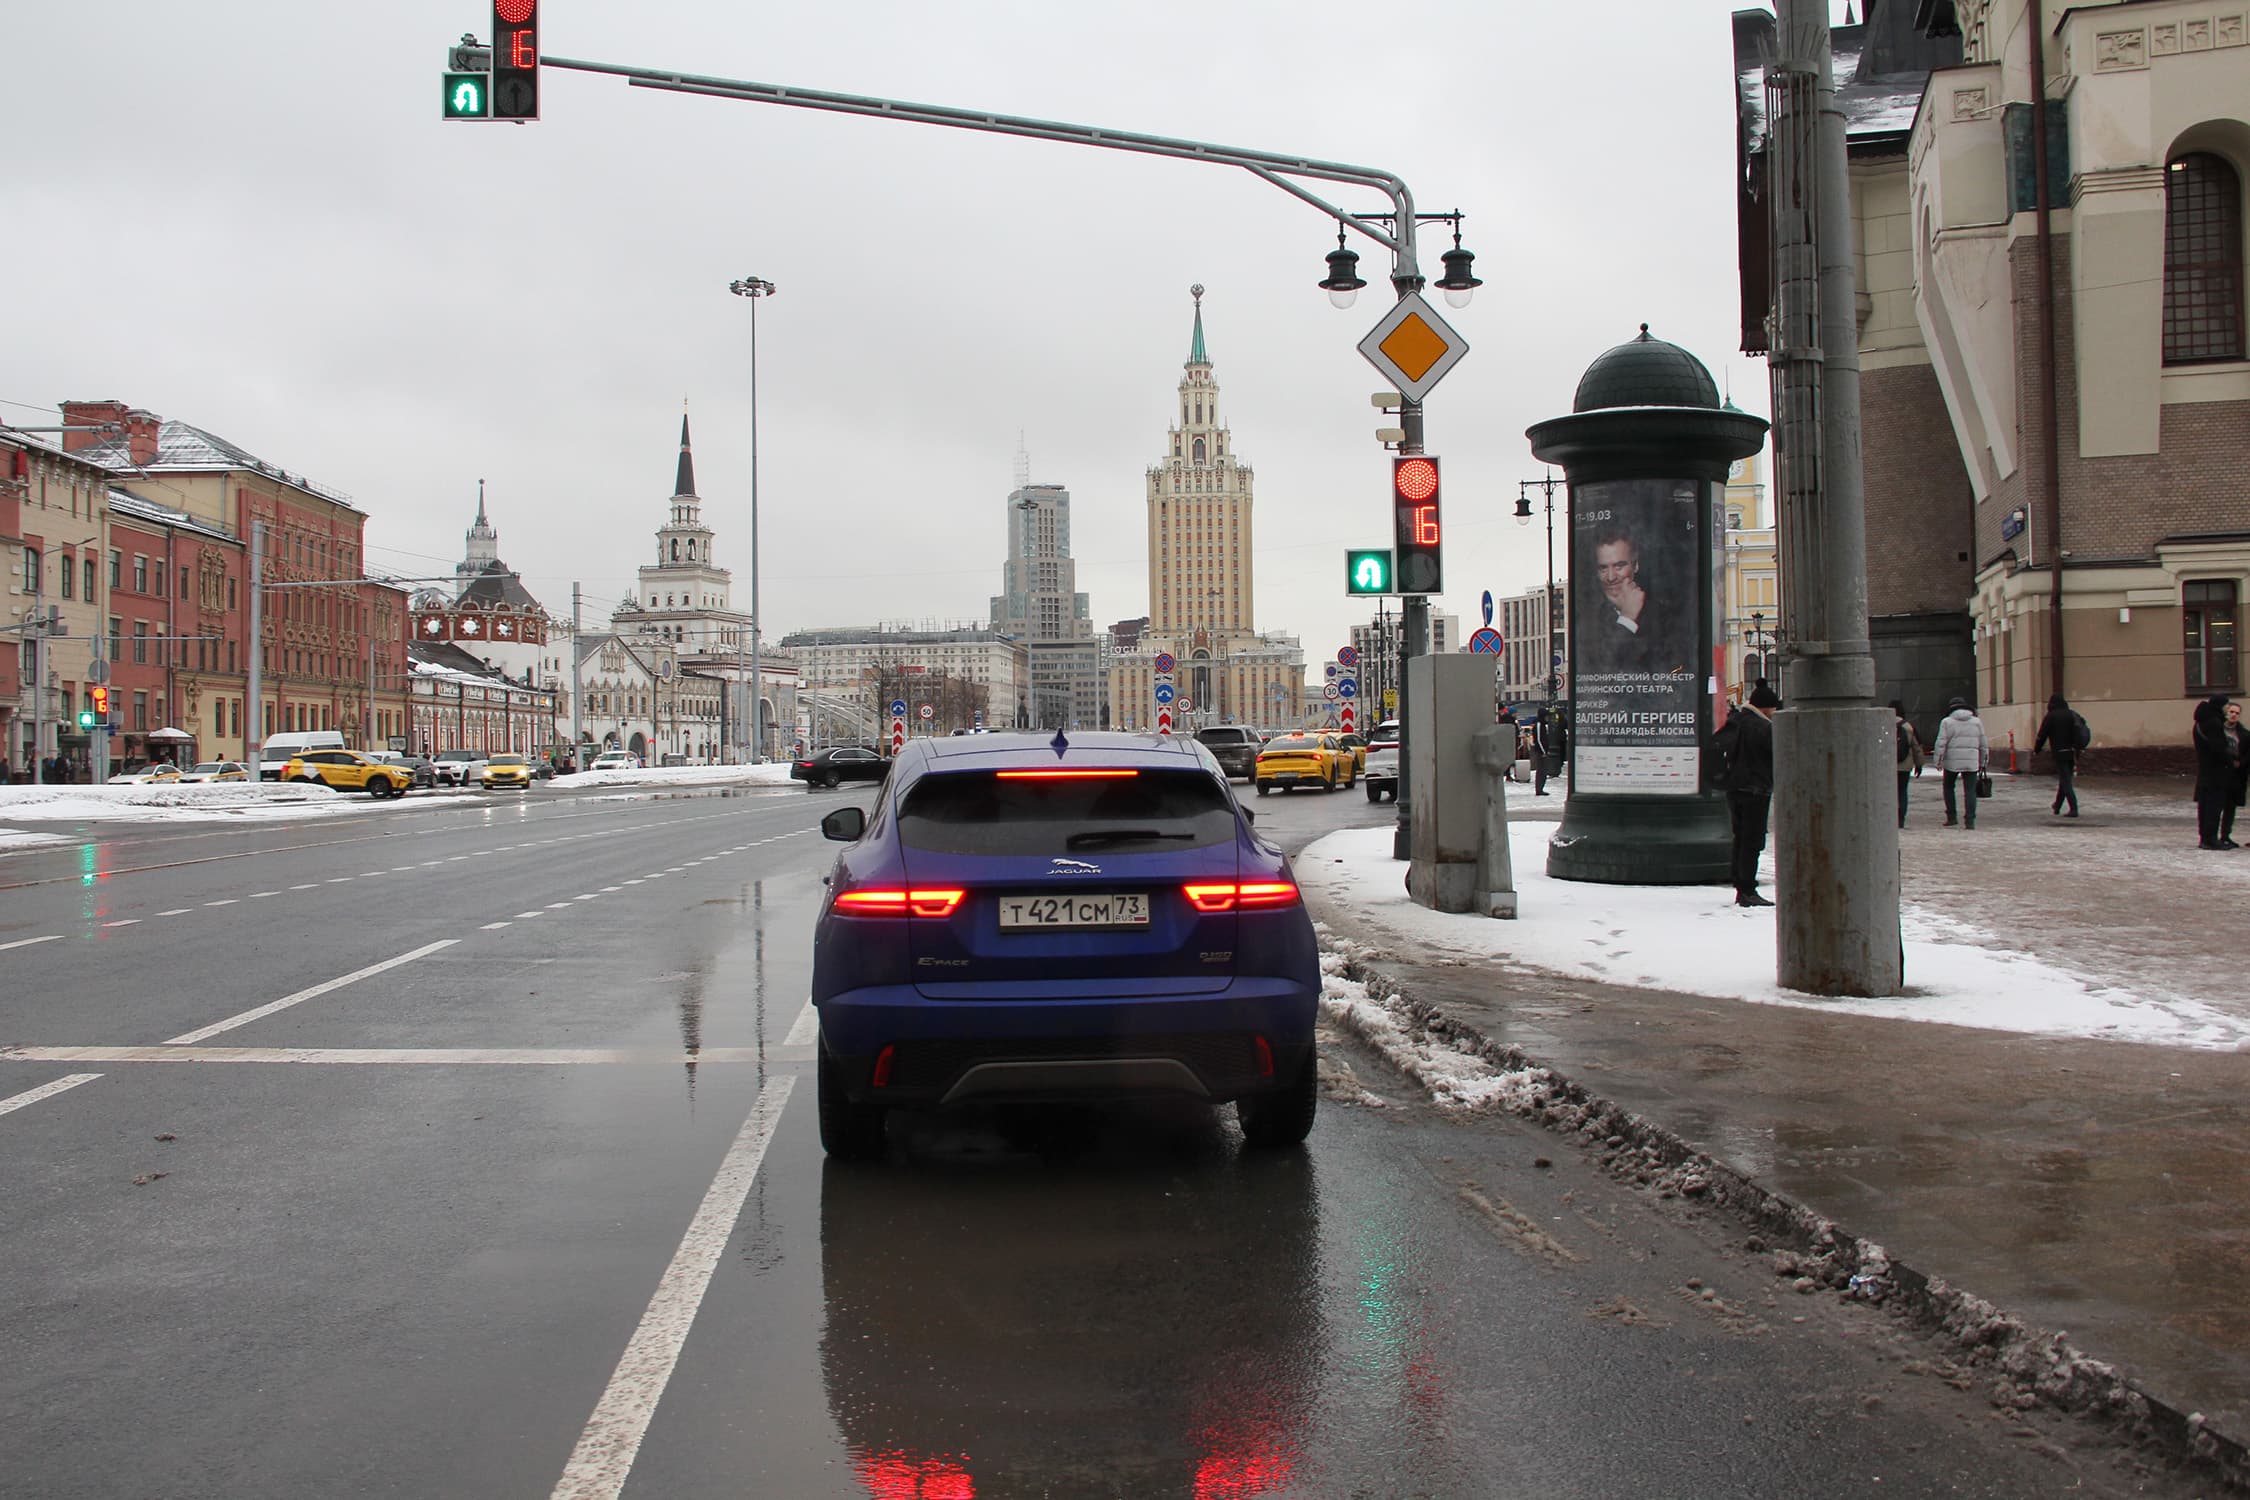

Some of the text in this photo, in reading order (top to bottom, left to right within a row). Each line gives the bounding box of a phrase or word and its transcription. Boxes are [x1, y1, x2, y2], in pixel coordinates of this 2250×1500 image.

[513, 30, 534, 68] 16
[1415, 506, 1438, 544] 16
[1575, 672, 1695, 682] СИМФОНИЧЕСКИЙ ОРКЕСТР
[1327, 688, 1337, 696] 30
[1575, 685, 1674, 694] МАРИИНСКОГО ТЕАТРА
[1180, 700, 1190, 709] 50
[922, 706, 932, 716] 50
[1575, 710, 1695, 724] ВАЛЕРИЙ ГЕРГИЕВ
[1115, 896, 1139, 915] 73
